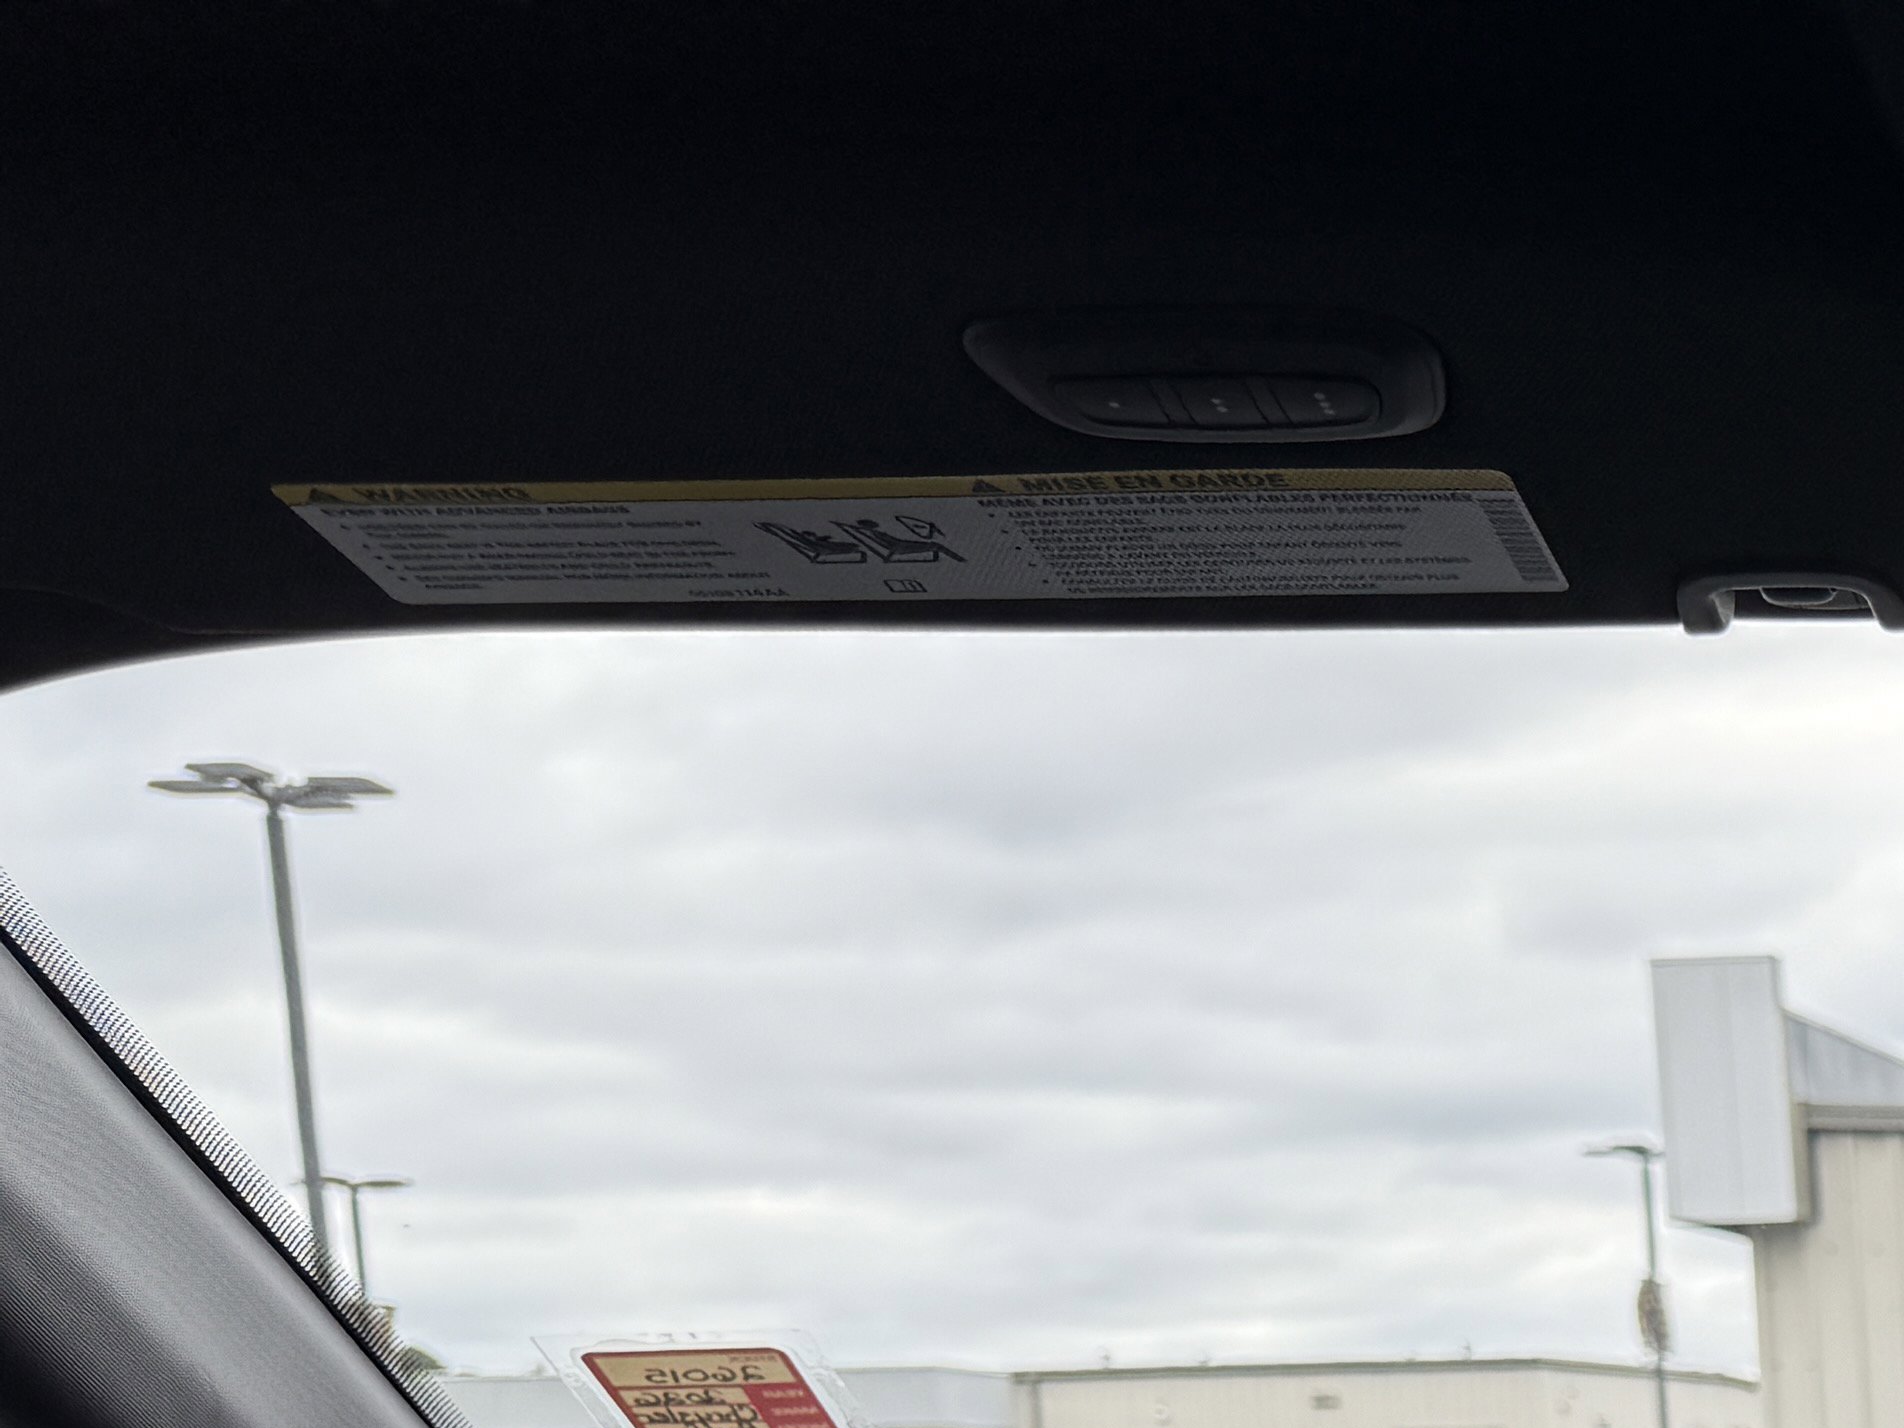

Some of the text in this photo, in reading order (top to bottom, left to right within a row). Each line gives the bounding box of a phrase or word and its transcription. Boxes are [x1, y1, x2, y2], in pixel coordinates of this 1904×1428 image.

[1020, 473, 1288, 492] MISE EN GARDE
